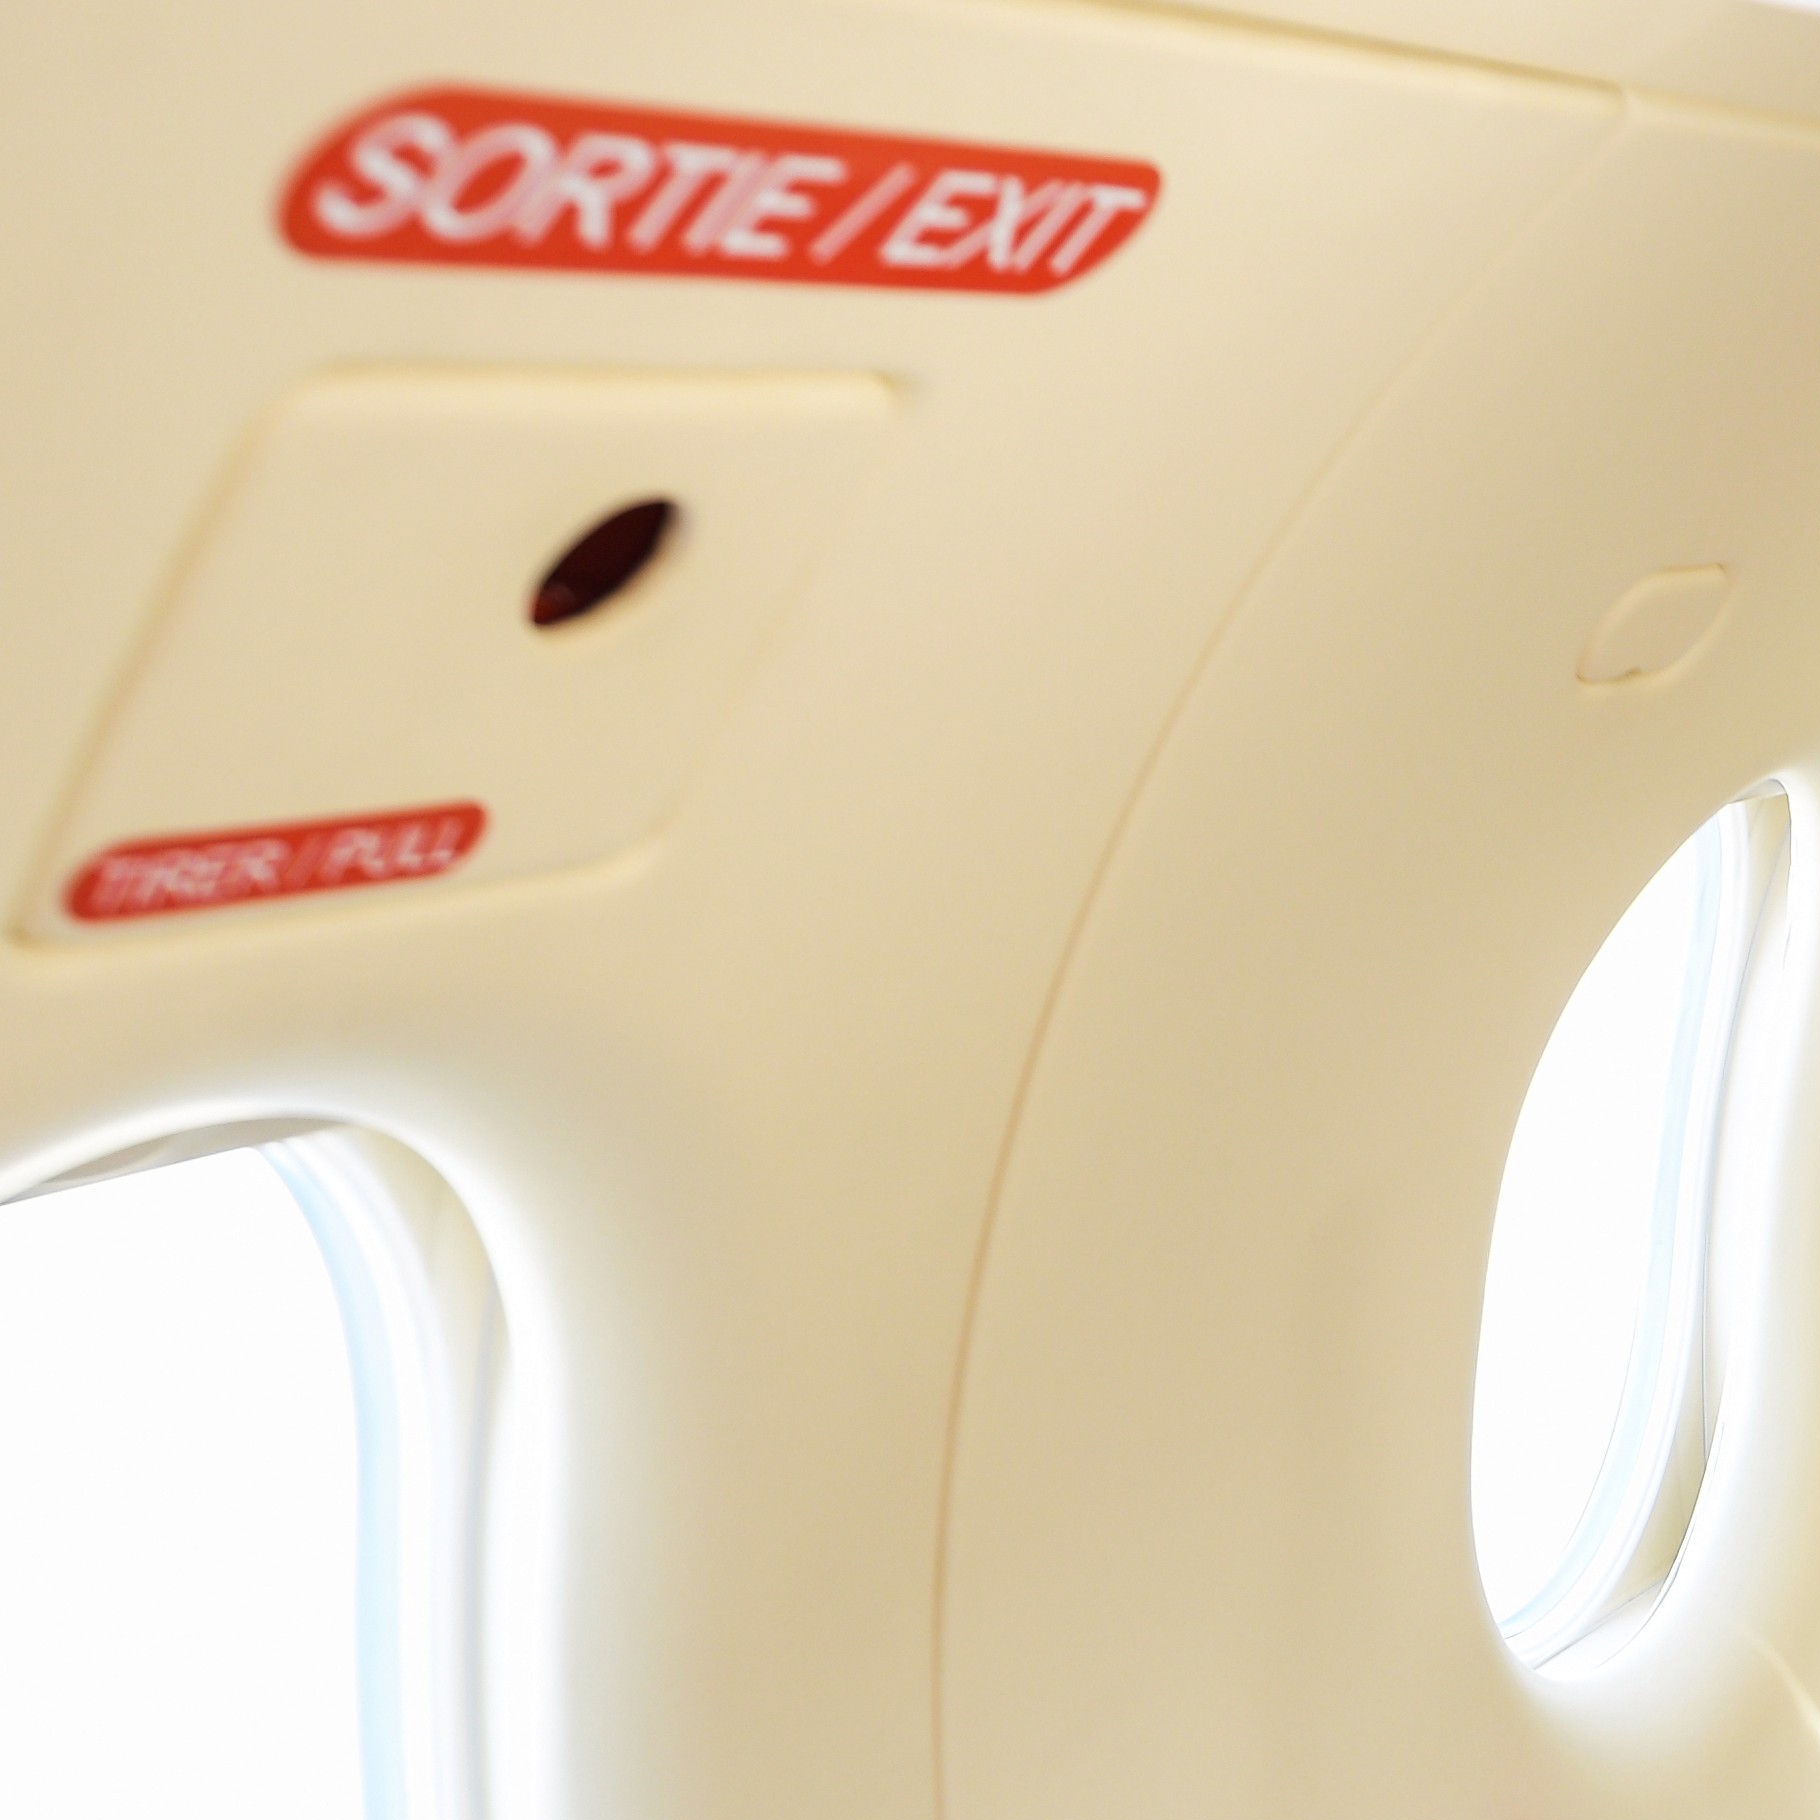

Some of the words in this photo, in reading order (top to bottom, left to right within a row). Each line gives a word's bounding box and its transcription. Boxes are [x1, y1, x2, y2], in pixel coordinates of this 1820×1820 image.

[312, 112, 846, 259] SORTIE
[878, 169, 1146, 276] EXIT
[93, 838, 291, 912] TIRER
[321, 815, 464, 886] PULL
